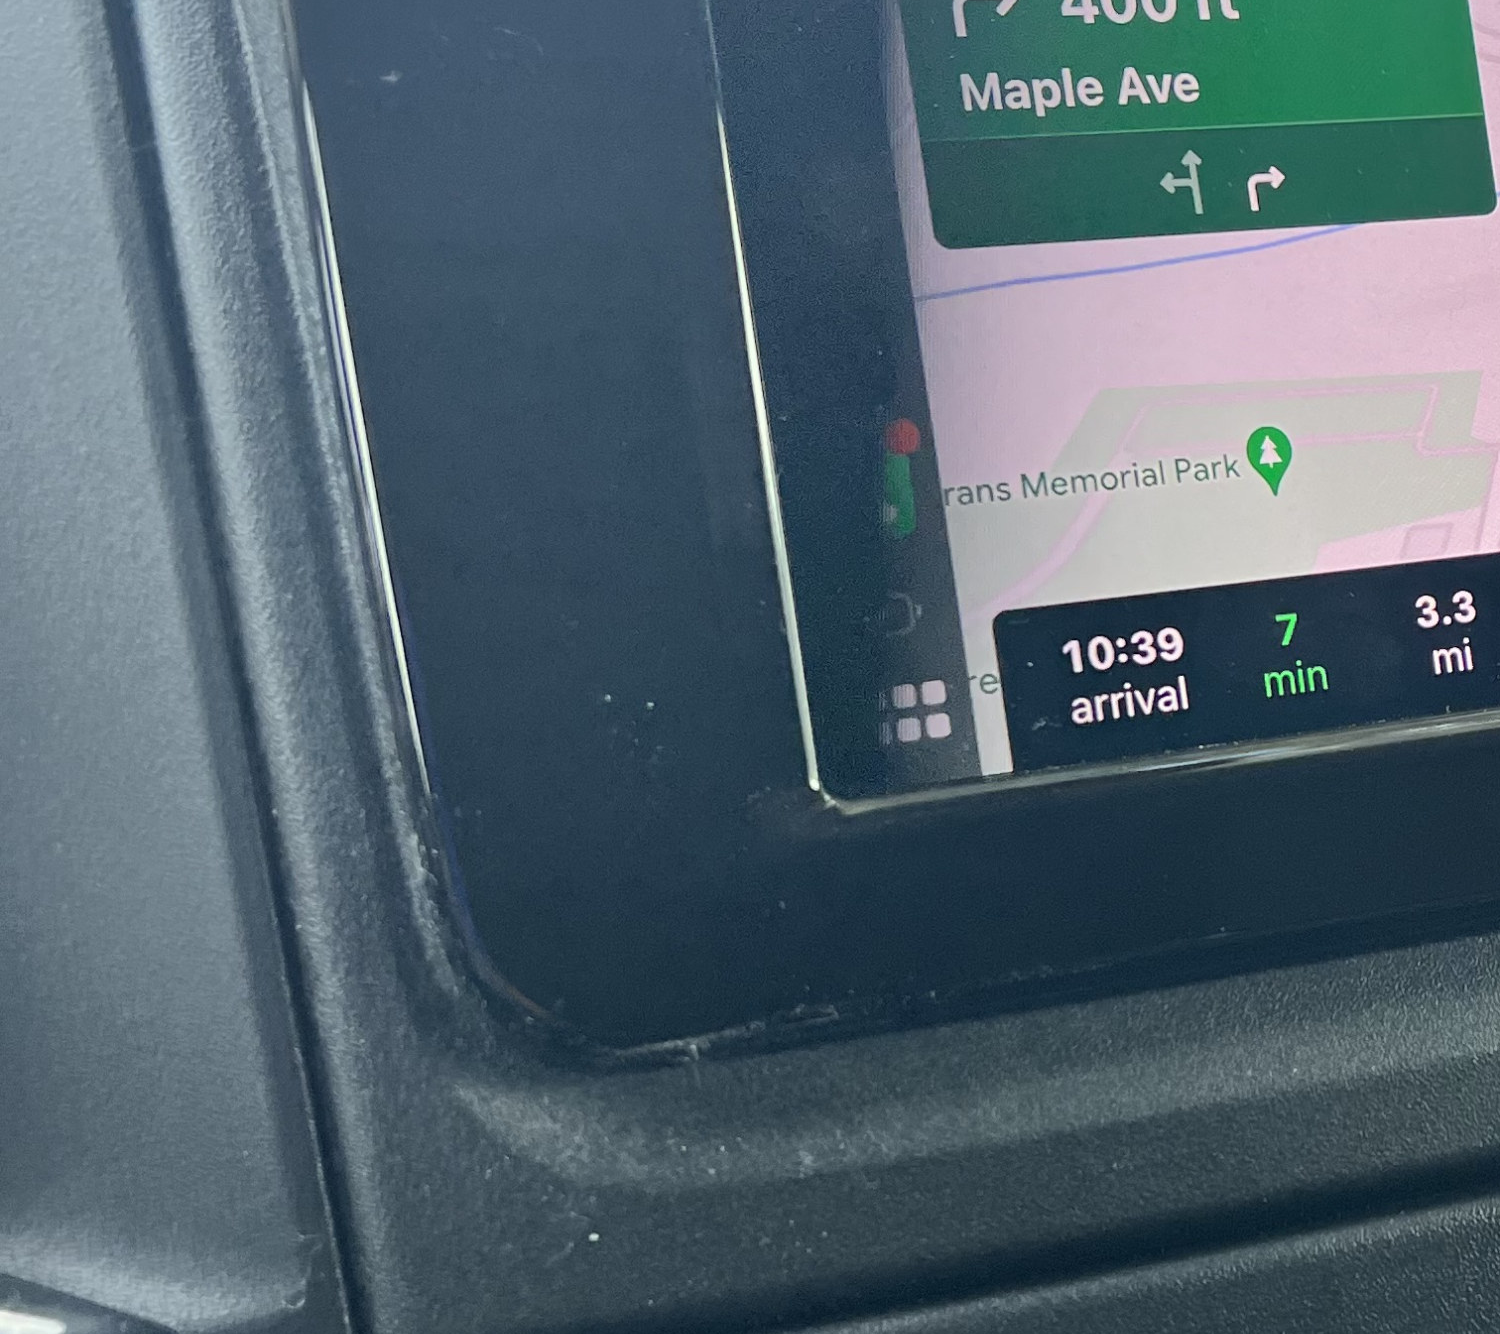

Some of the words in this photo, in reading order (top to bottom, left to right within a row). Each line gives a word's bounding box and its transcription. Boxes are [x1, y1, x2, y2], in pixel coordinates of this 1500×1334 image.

[960, 68, 1105, 117] Maple
[1117, 66, 1201, 107] Ave
[1020, 461, 1167, 499] Memorial
[1176, 453, 1241, 482] Park
[1273, 613, 1299, 647] 7
[1413, 590, 1478, 629] 3.3
[1061, 626, 1186, 675] 10:39
[1431, 639, 1475, 676] mi
[1069, 676, 1191, 725] arrival
[1263, 660, 1330, 699] min
